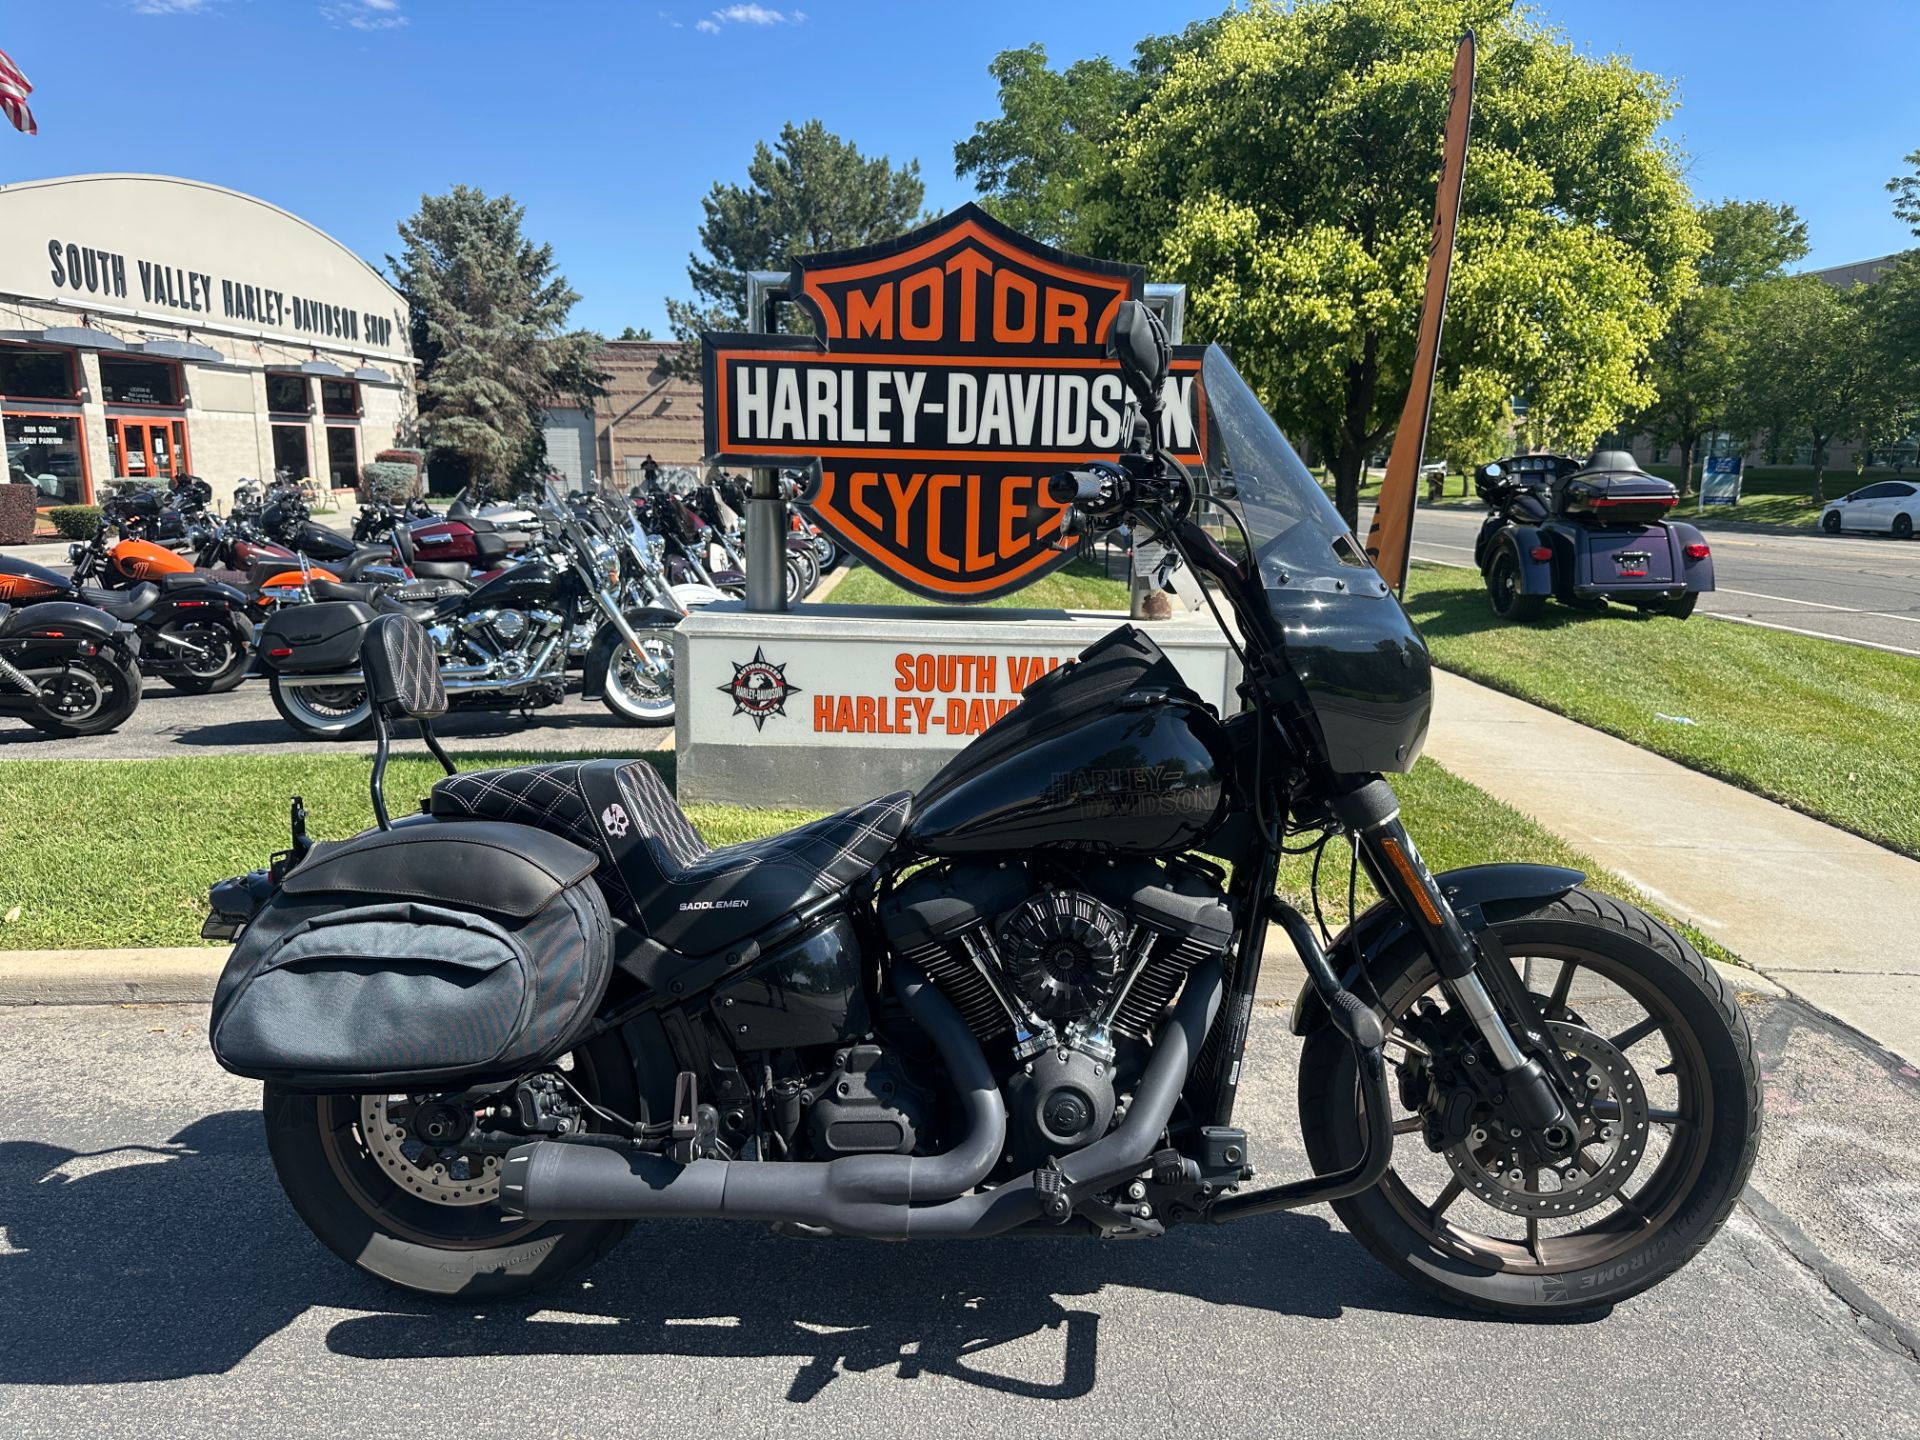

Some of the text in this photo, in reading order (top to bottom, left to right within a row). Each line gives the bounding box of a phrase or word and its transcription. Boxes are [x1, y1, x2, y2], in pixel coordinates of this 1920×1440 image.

[48, 239, 392, 347] SOUTH VALLEY HARLEY-DAVIDSON SHOP
[846, 247, 1090, 345] MOTOR
[849, 473, 1074, 573] CYCLES
[737, 663, 782, 680] AUTHORIZED
[894, 653, 996, 693] SOUTH
[735, 685, 783, 701] HARLEY-DAVIDSON
[739, 701, 780, 716] RENTALS
[1081, 785, 1213, 820] DAVIDSON
[679, 899, 749, 912] SADDLEMEN
[1579, 1238, 1670, 1289] CHROME
